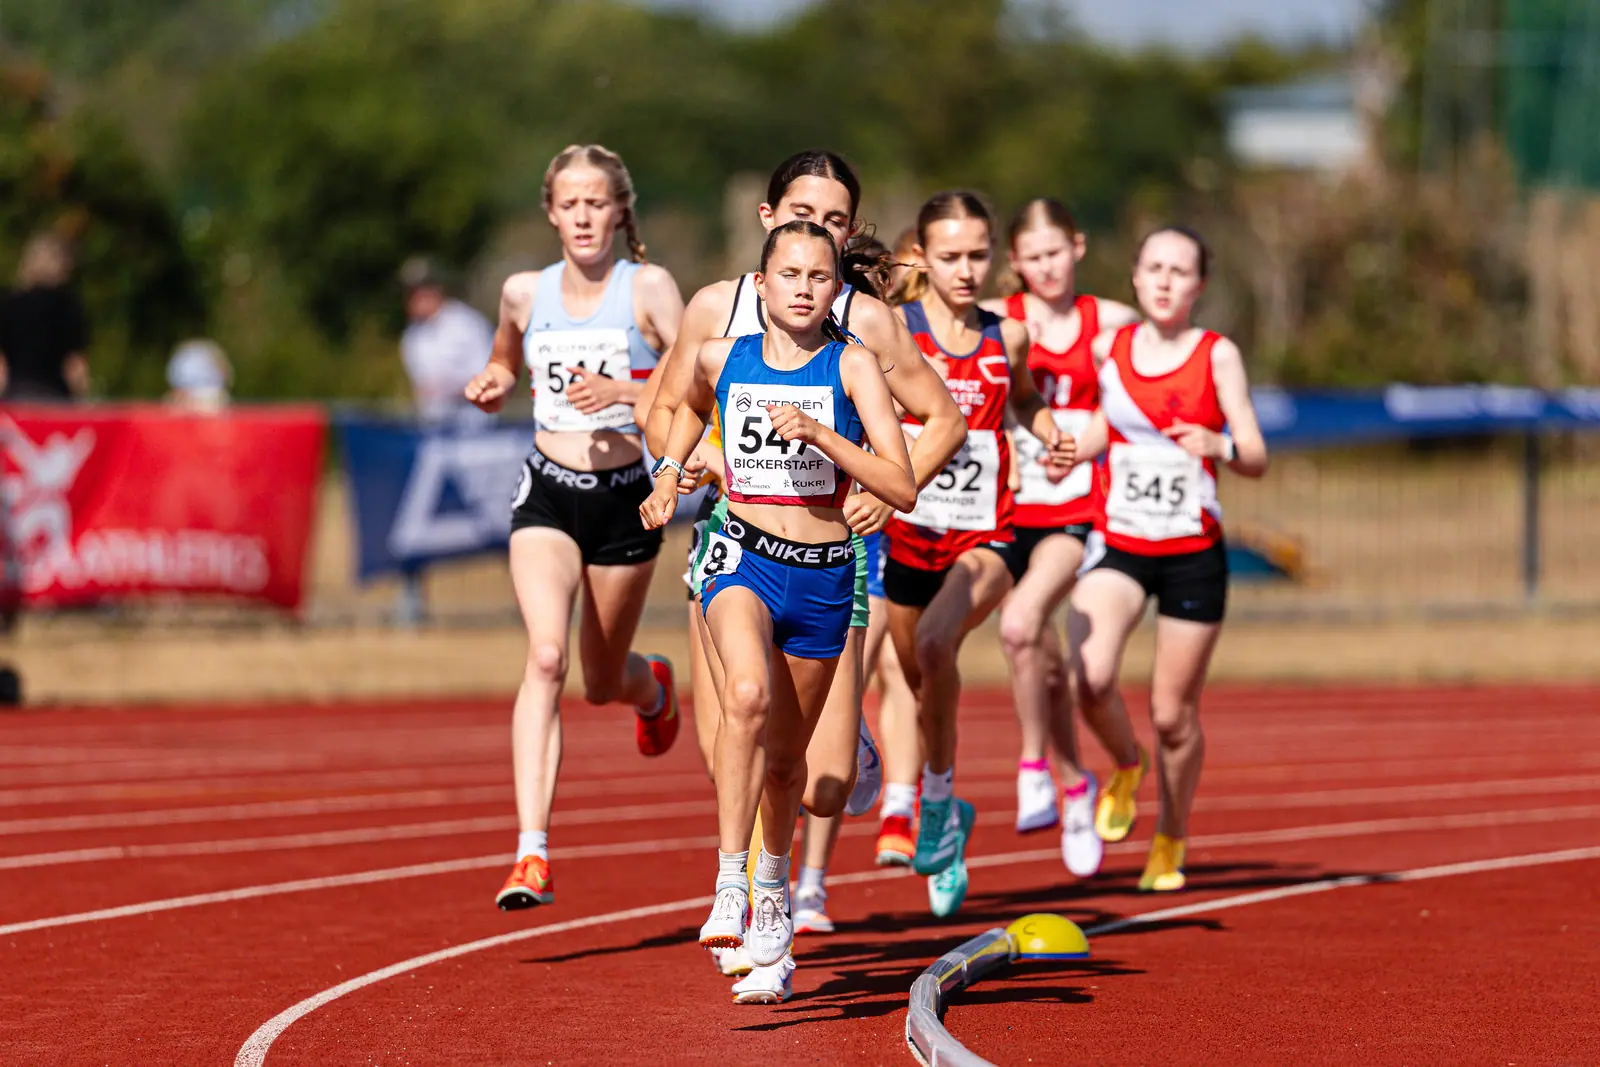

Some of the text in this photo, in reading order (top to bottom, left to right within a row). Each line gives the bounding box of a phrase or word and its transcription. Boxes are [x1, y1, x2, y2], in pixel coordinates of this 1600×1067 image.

[541, 465, 599, 490] PRO
[734, 458, 824, 471] BICKERSTAFF
[936, 458, 983, 492] 52
[792, 480, 826, 488] KUKRI
[1125, 472, 1187, 507] 545
[723, 514, 854, 564] RO NIKE PR
